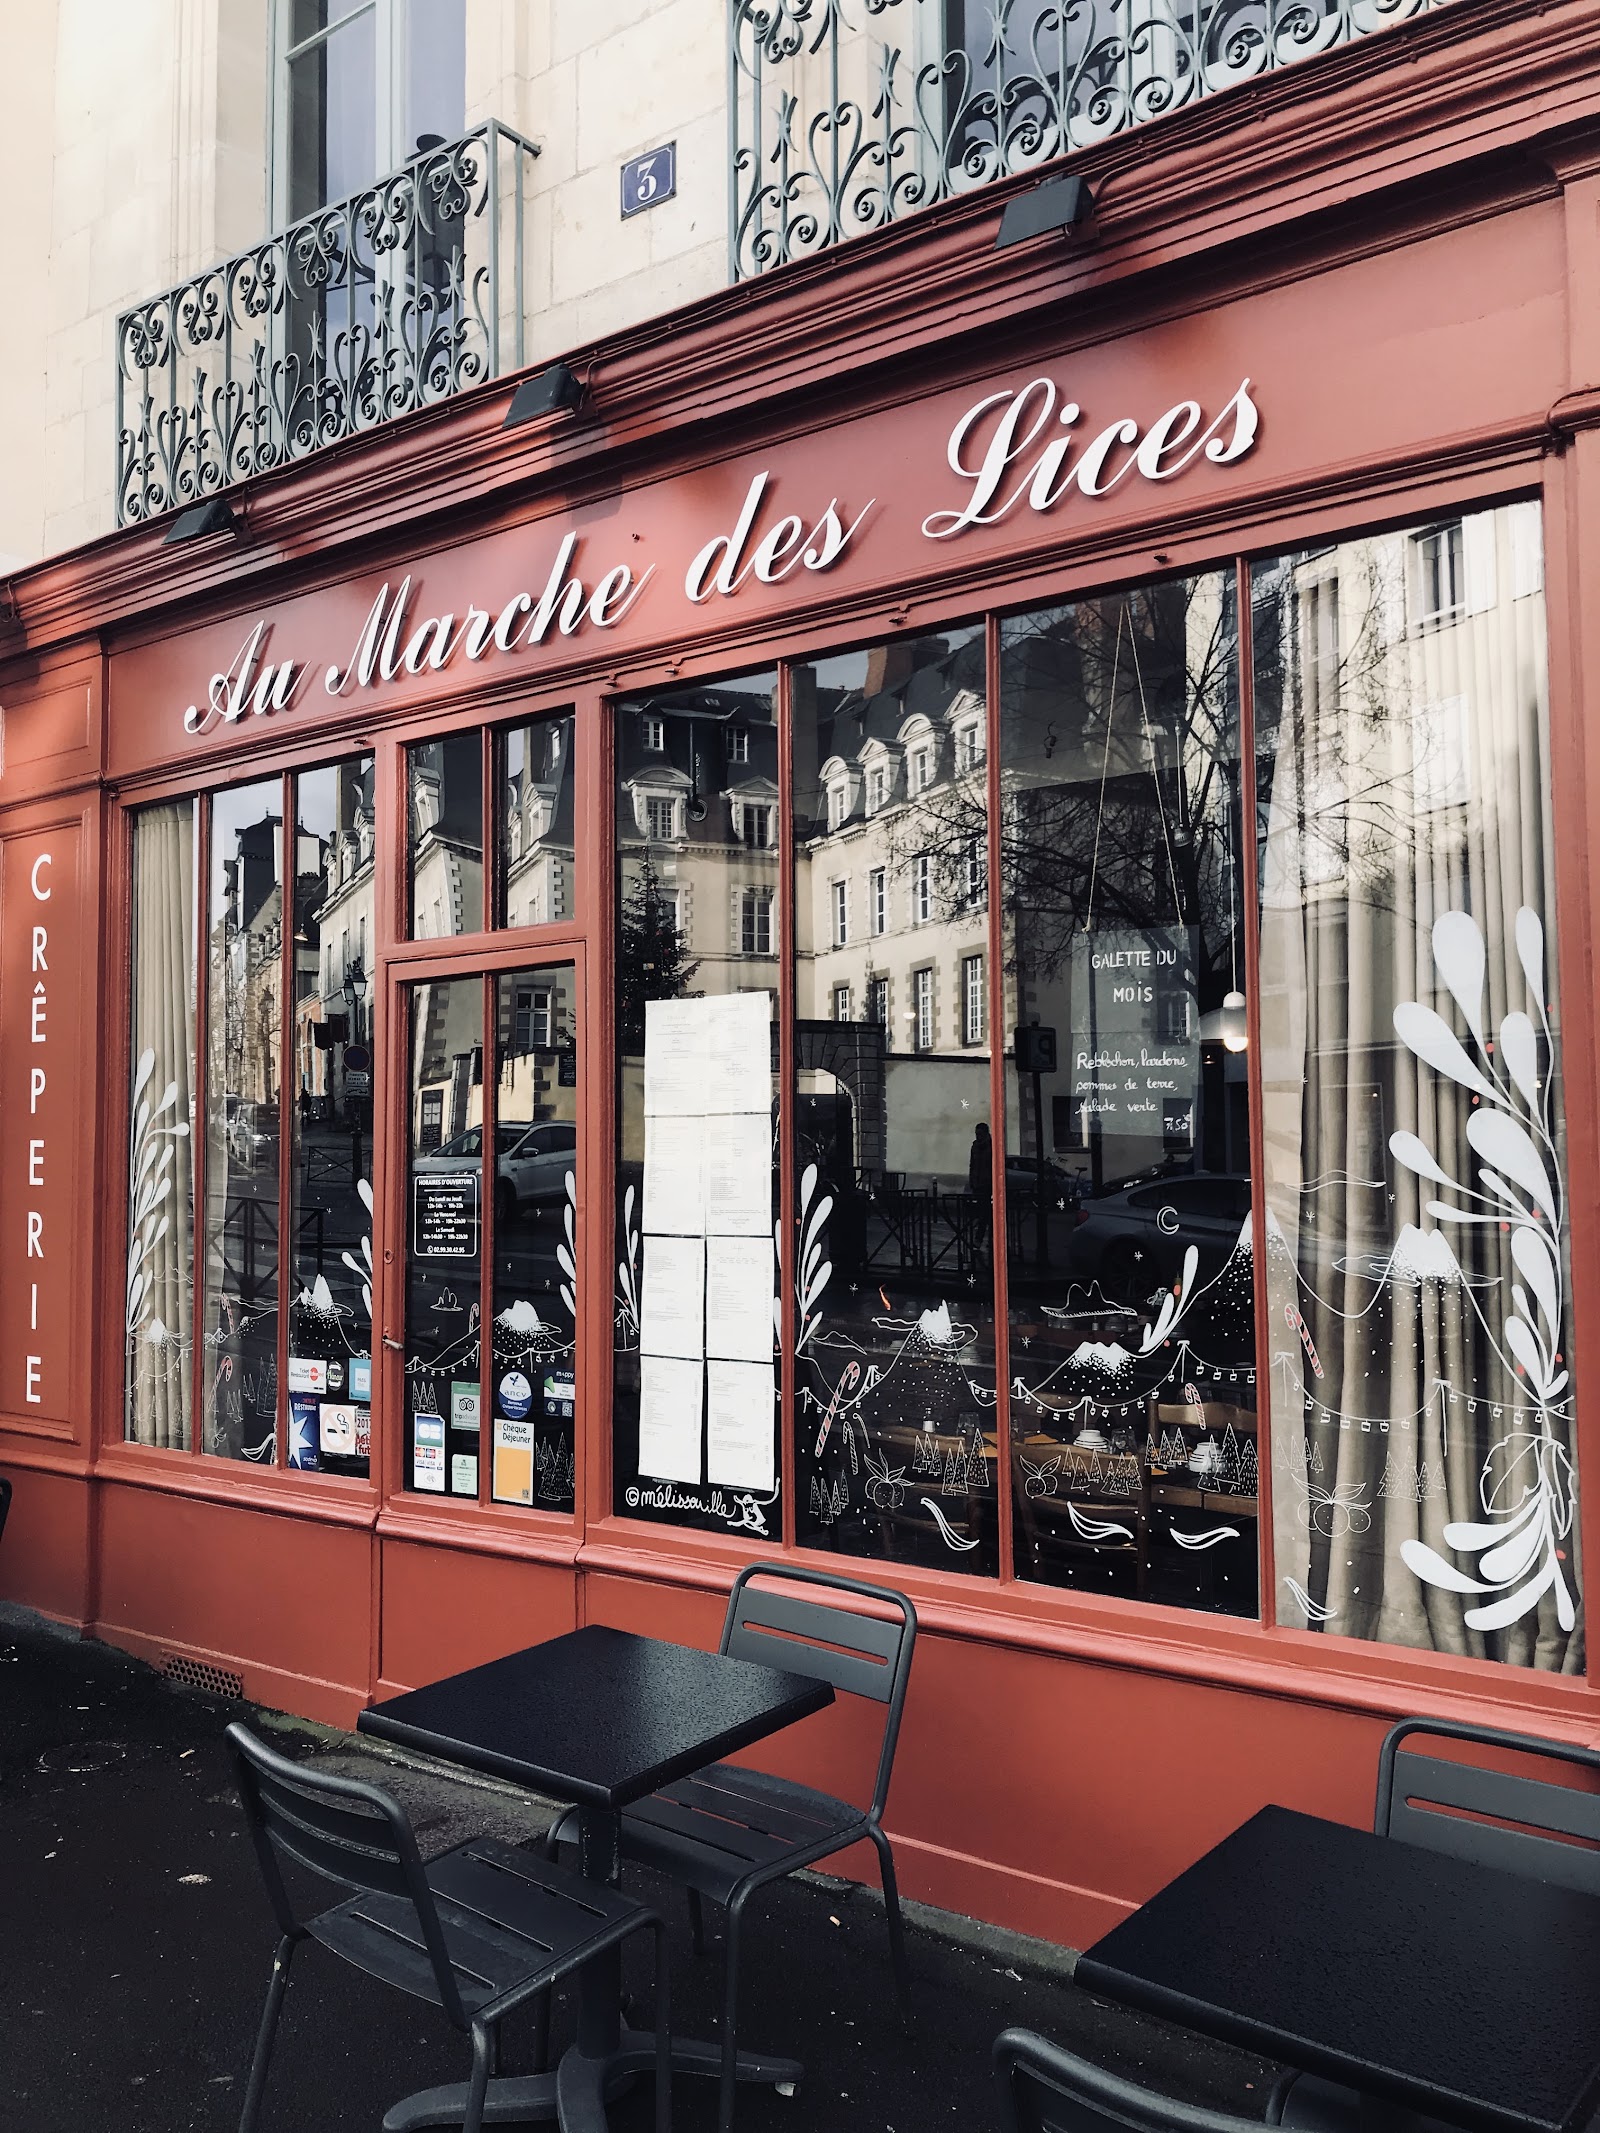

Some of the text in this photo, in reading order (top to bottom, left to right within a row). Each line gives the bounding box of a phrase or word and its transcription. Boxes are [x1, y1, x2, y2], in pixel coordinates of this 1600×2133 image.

[637, 157, 657, 201] 3
[184, 620, 311, 734] Au
[685, 471, 876, 602] des
[922, 378, 1259, 538] Lices
[1091, 949, 1177, 969] GALETTE DU
[1077, 1048, 1188, 1069] Reblochon, lardons,
[1075, 1077, 1178, 1094] pommes de terre,
[1075, 1097, 1158, 1115] salade verte
[27, 854, 52, 1402] CRÊPERIE
[504, 1390, 527, 1398] ancv
[502, 1423, 527, 1434] Chèque
[502, 1433, 531, 1444] Déjeuner
